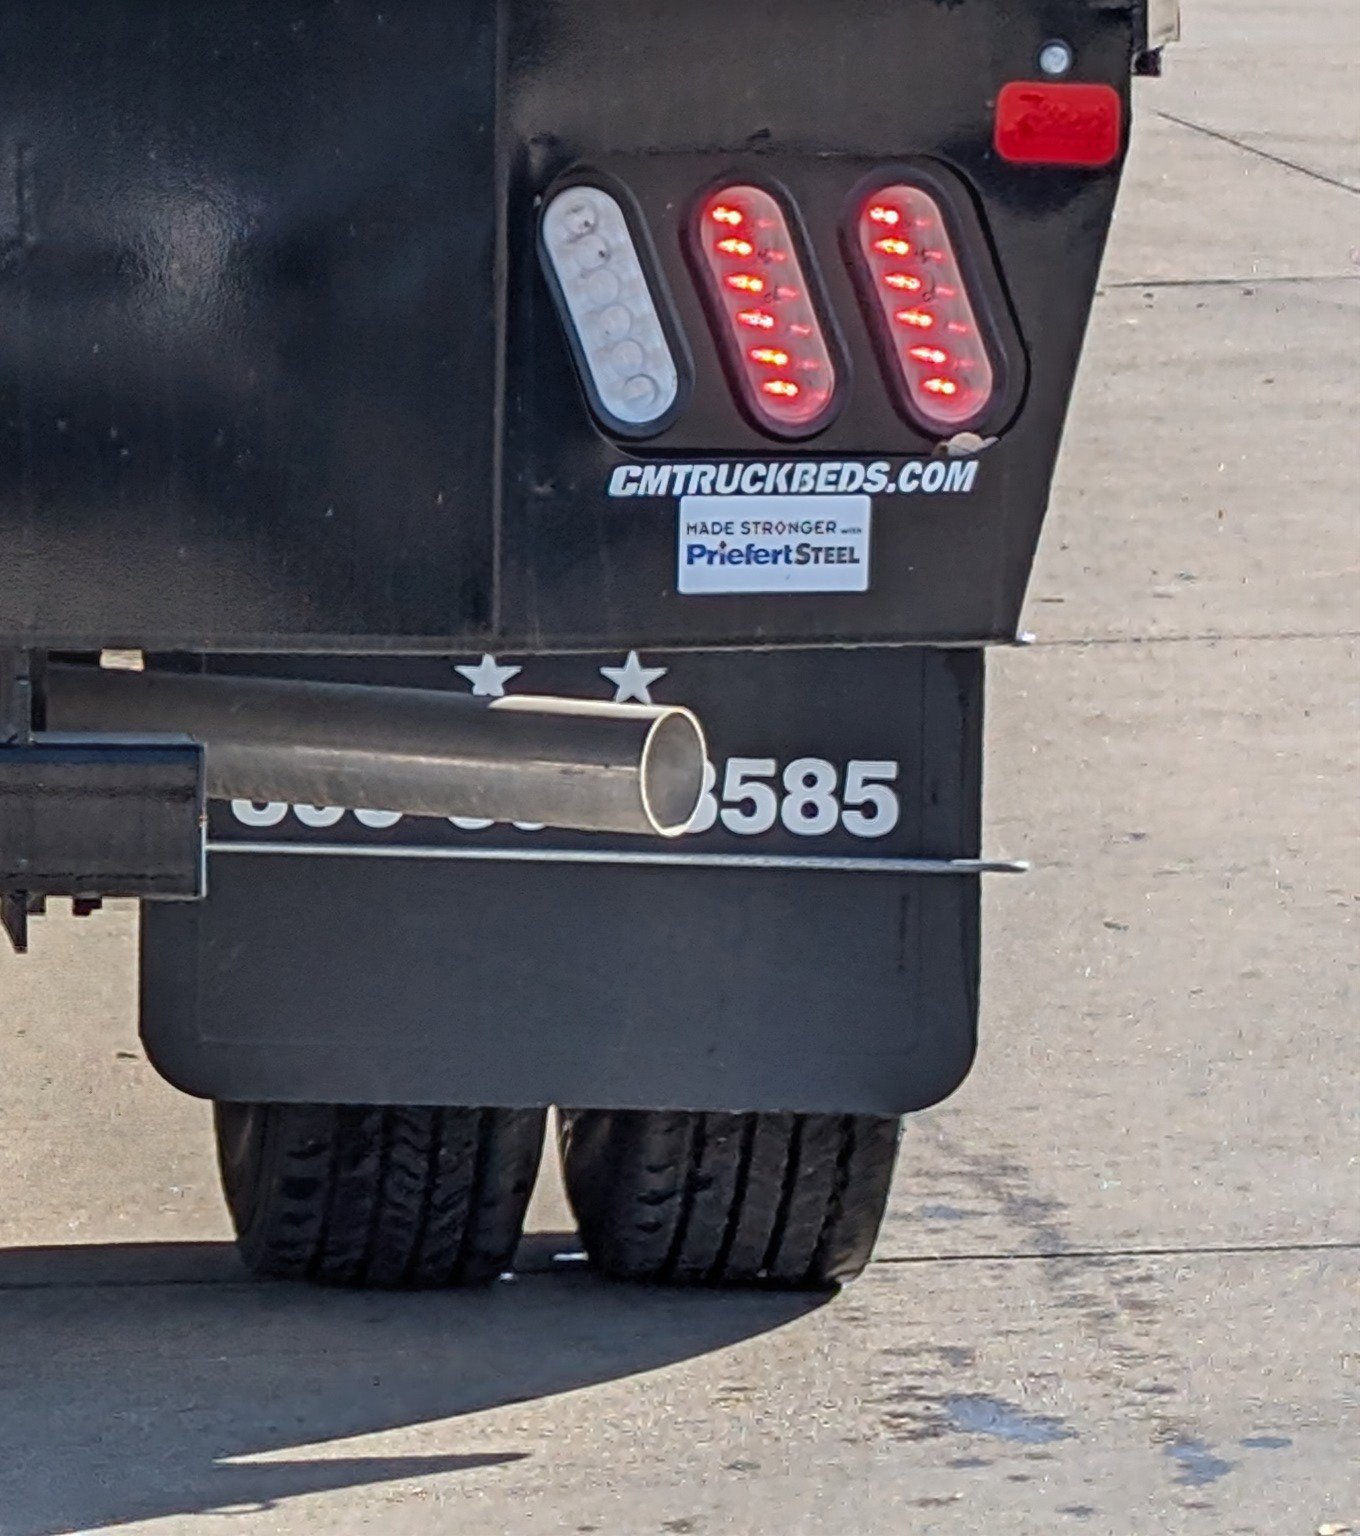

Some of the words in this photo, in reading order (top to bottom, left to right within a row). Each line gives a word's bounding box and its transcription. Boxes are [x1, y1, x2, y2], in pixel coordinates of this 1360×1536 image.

[607, 460, 979, 497] CMTRUCKBEDS.COM
[686, 521, 734, 536] MADE
[740, 520, 837, 535] STRONGER
